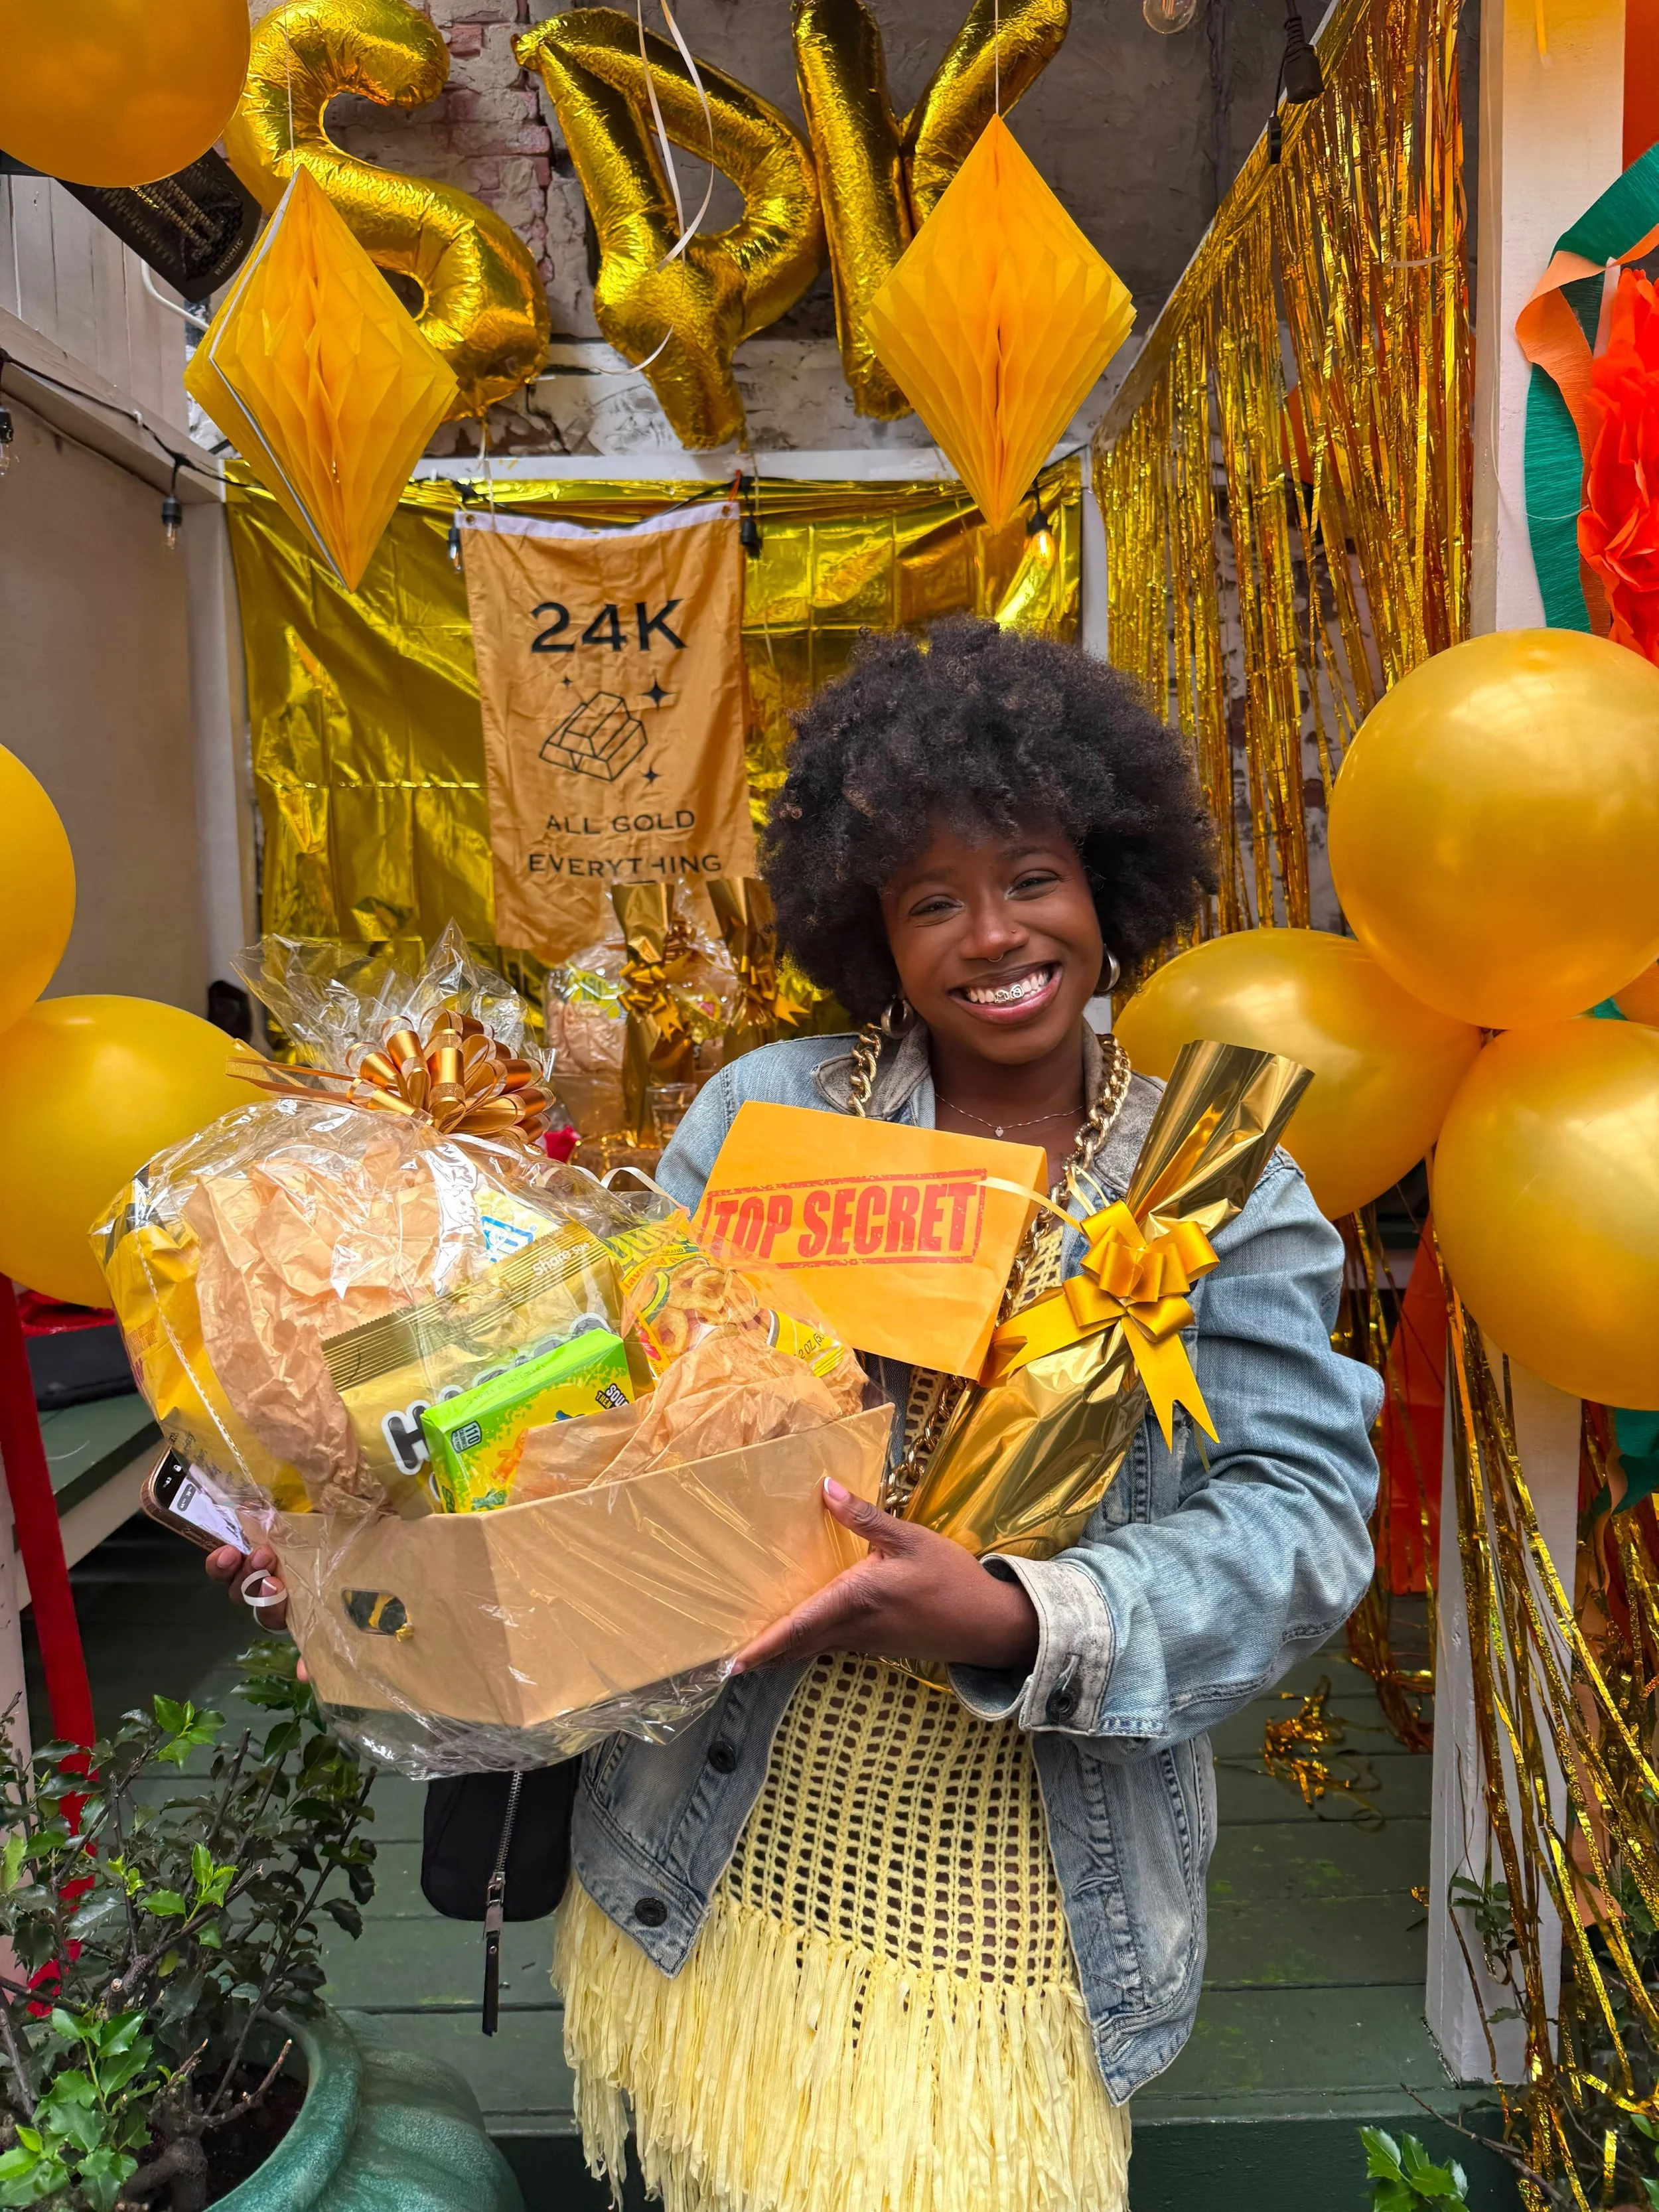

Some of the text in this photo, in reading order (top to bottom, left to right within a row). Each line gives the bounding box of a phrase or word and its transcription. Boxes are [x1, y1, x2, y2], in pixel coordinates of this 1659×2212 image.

[214, 238, 244, 276] BROMIC
[530, 599, 687, 652] 24K
[546, 810, 695, 835] ALL GOLD
[528, 854, 722, 877] EVERYTHING
[709, 1195, 794, 1259] TOP
[798, 1183, 977, 1258] SECRET
[532, 1242, 590, 1276] Share Size
[804, 1341, 817, 1355] OZ
[597, 1391, 613, 1410] THEN
[465, 1424, 480, 1445] 110
